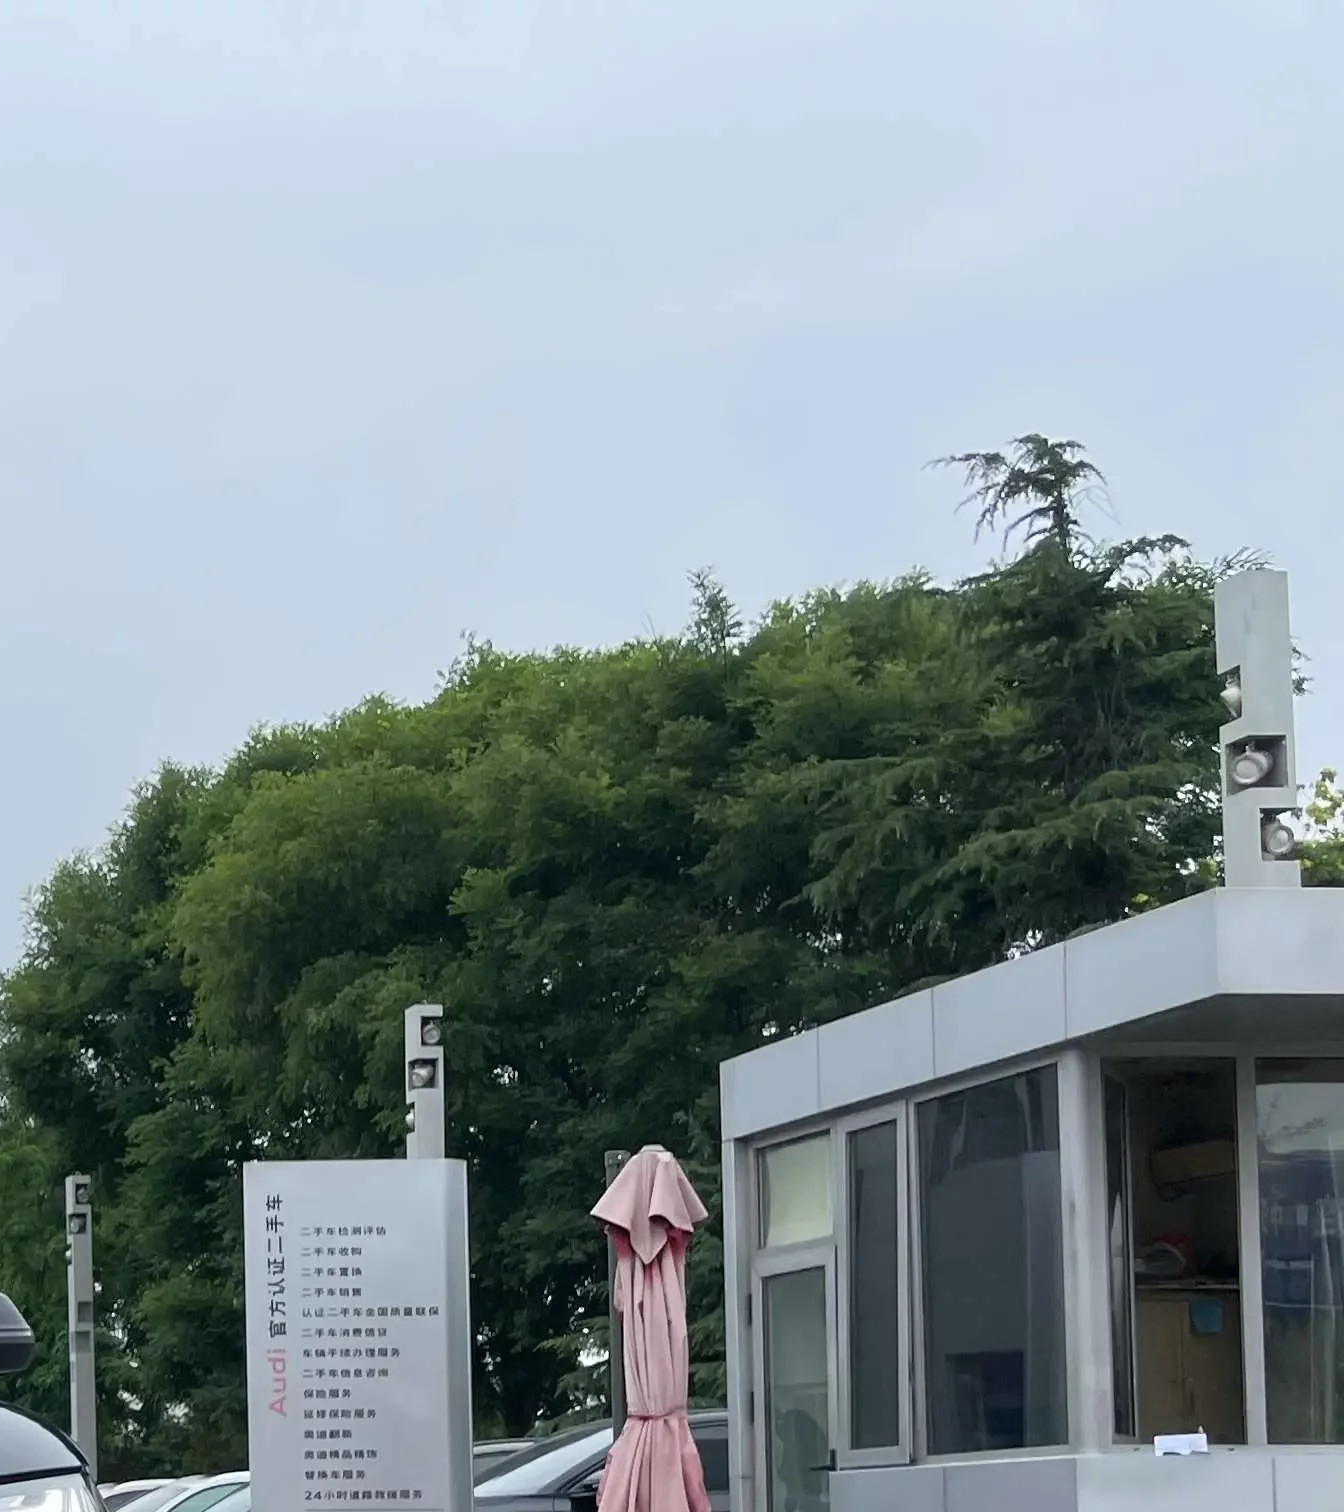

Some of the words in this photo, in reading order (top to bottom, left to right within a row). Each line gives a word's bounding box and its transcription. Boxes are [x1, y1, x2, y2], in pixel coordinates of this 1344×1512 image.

[265, 1193, 288, 1339] 官方认证二手车
[267, 1349, 288, 1418] Audi
